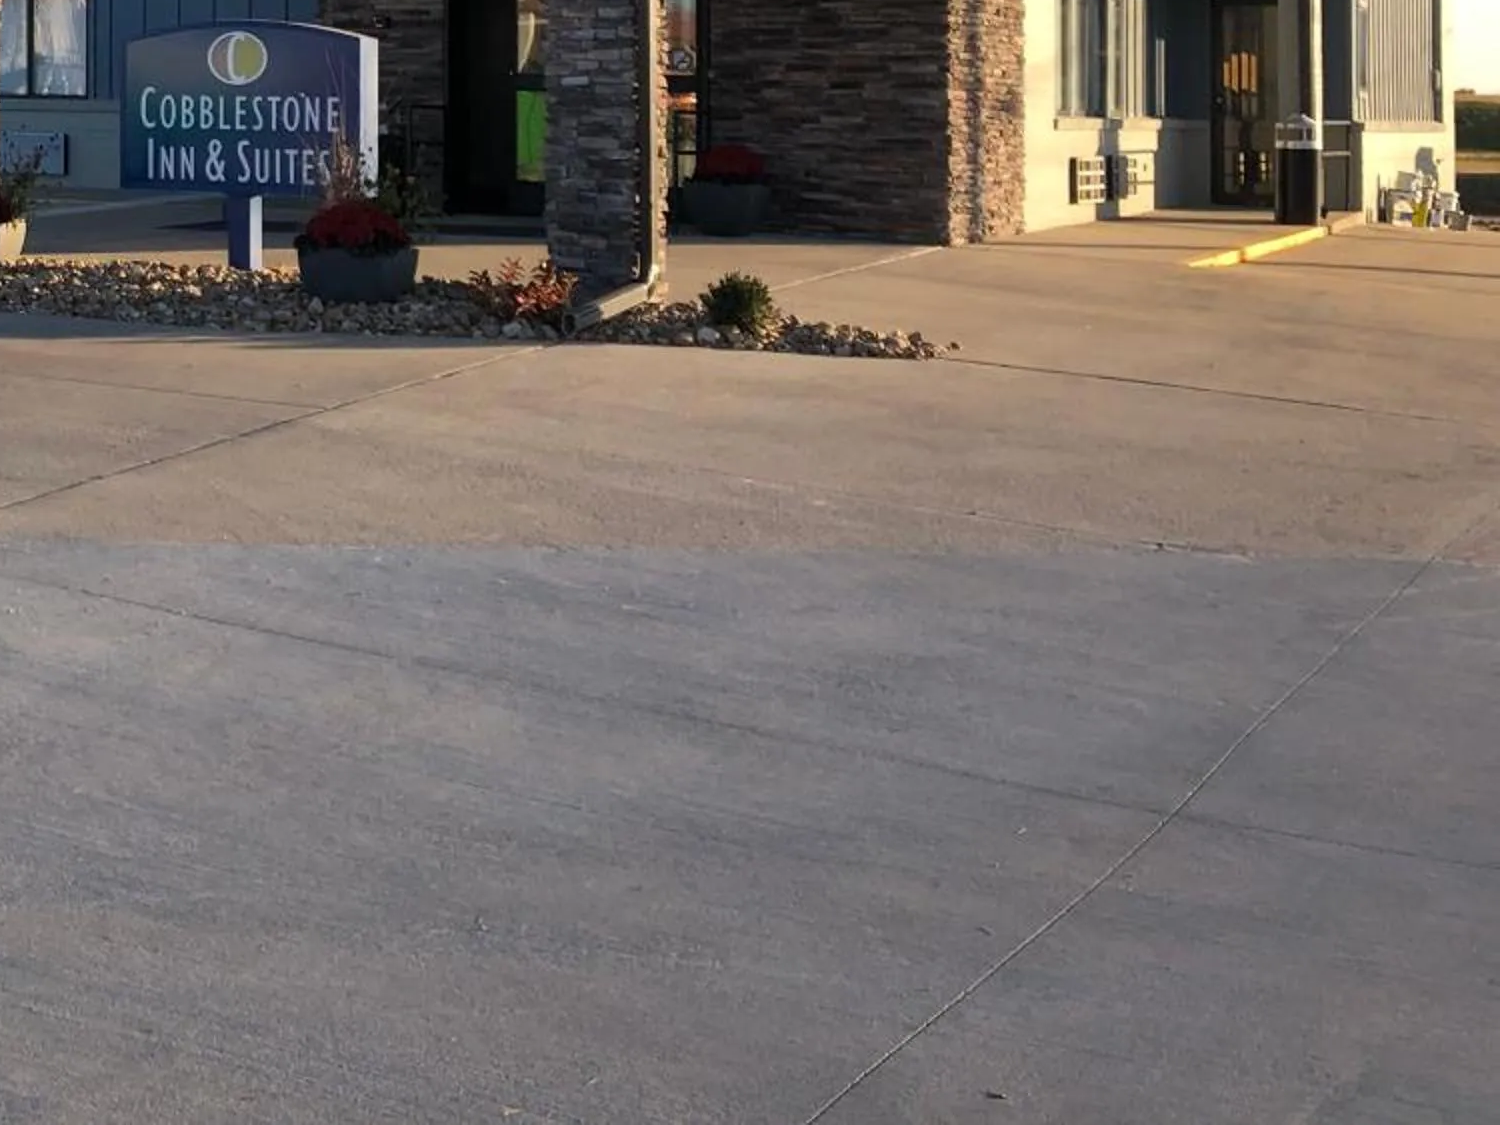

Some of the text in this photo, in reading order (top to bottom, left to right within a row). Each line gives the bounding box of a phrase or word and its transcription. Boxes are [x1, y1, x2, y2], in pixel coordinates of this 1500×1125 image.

[140, 87, 341, 132] COBBLESTONE
[147, 138, 196, 181] INN
[205, 139, 226, 182] &
